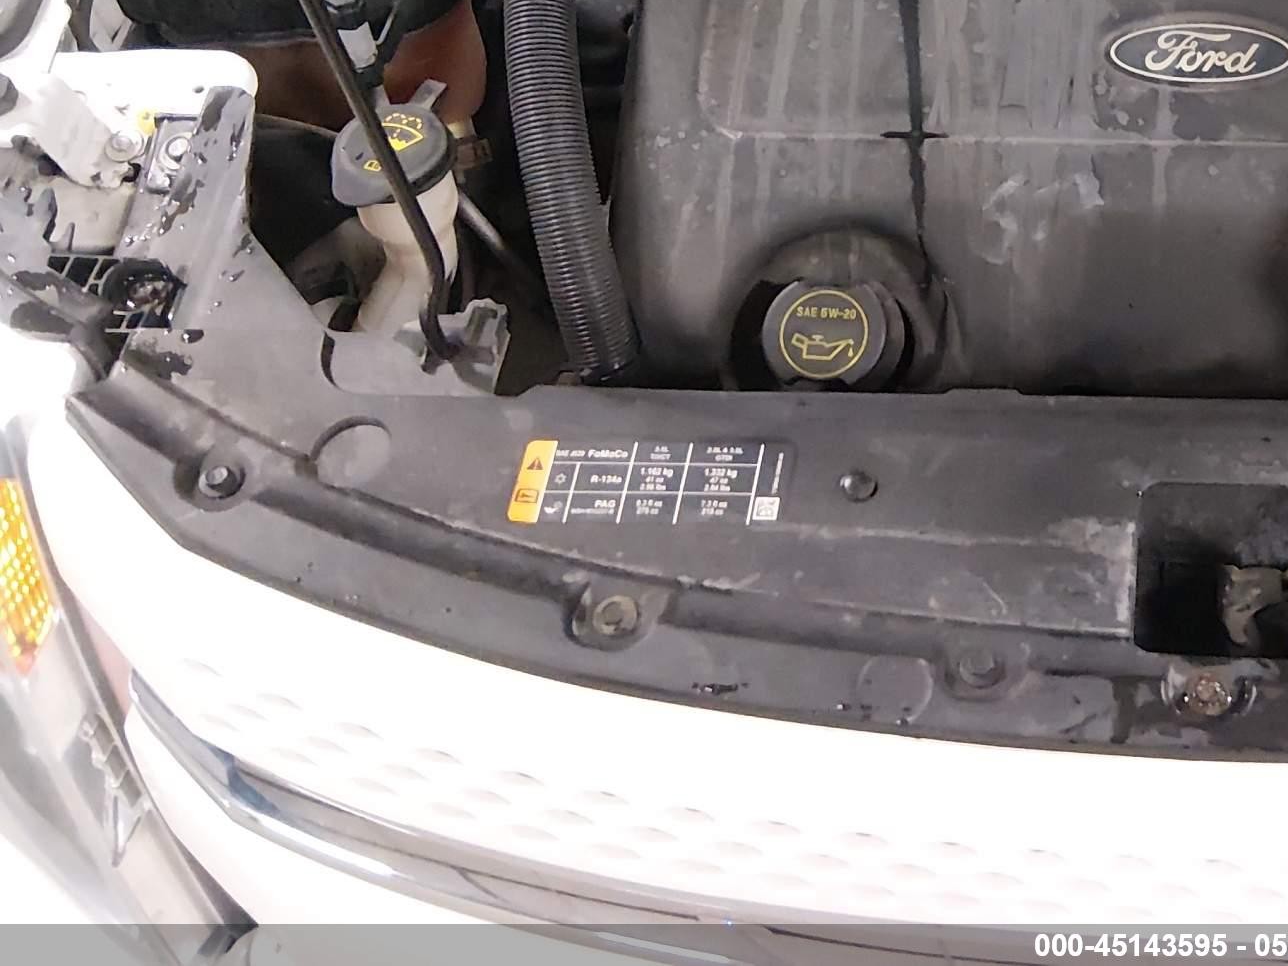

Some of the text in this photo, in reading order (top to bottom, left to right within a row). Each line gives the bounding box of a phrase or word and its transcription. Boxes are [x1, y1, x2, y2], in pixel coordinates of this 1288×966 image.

[1144, 30, 1260, 74] Ford
[796, 306, 857, 320] SAE 5W-20
[594, 499, 617, 508] PAG
